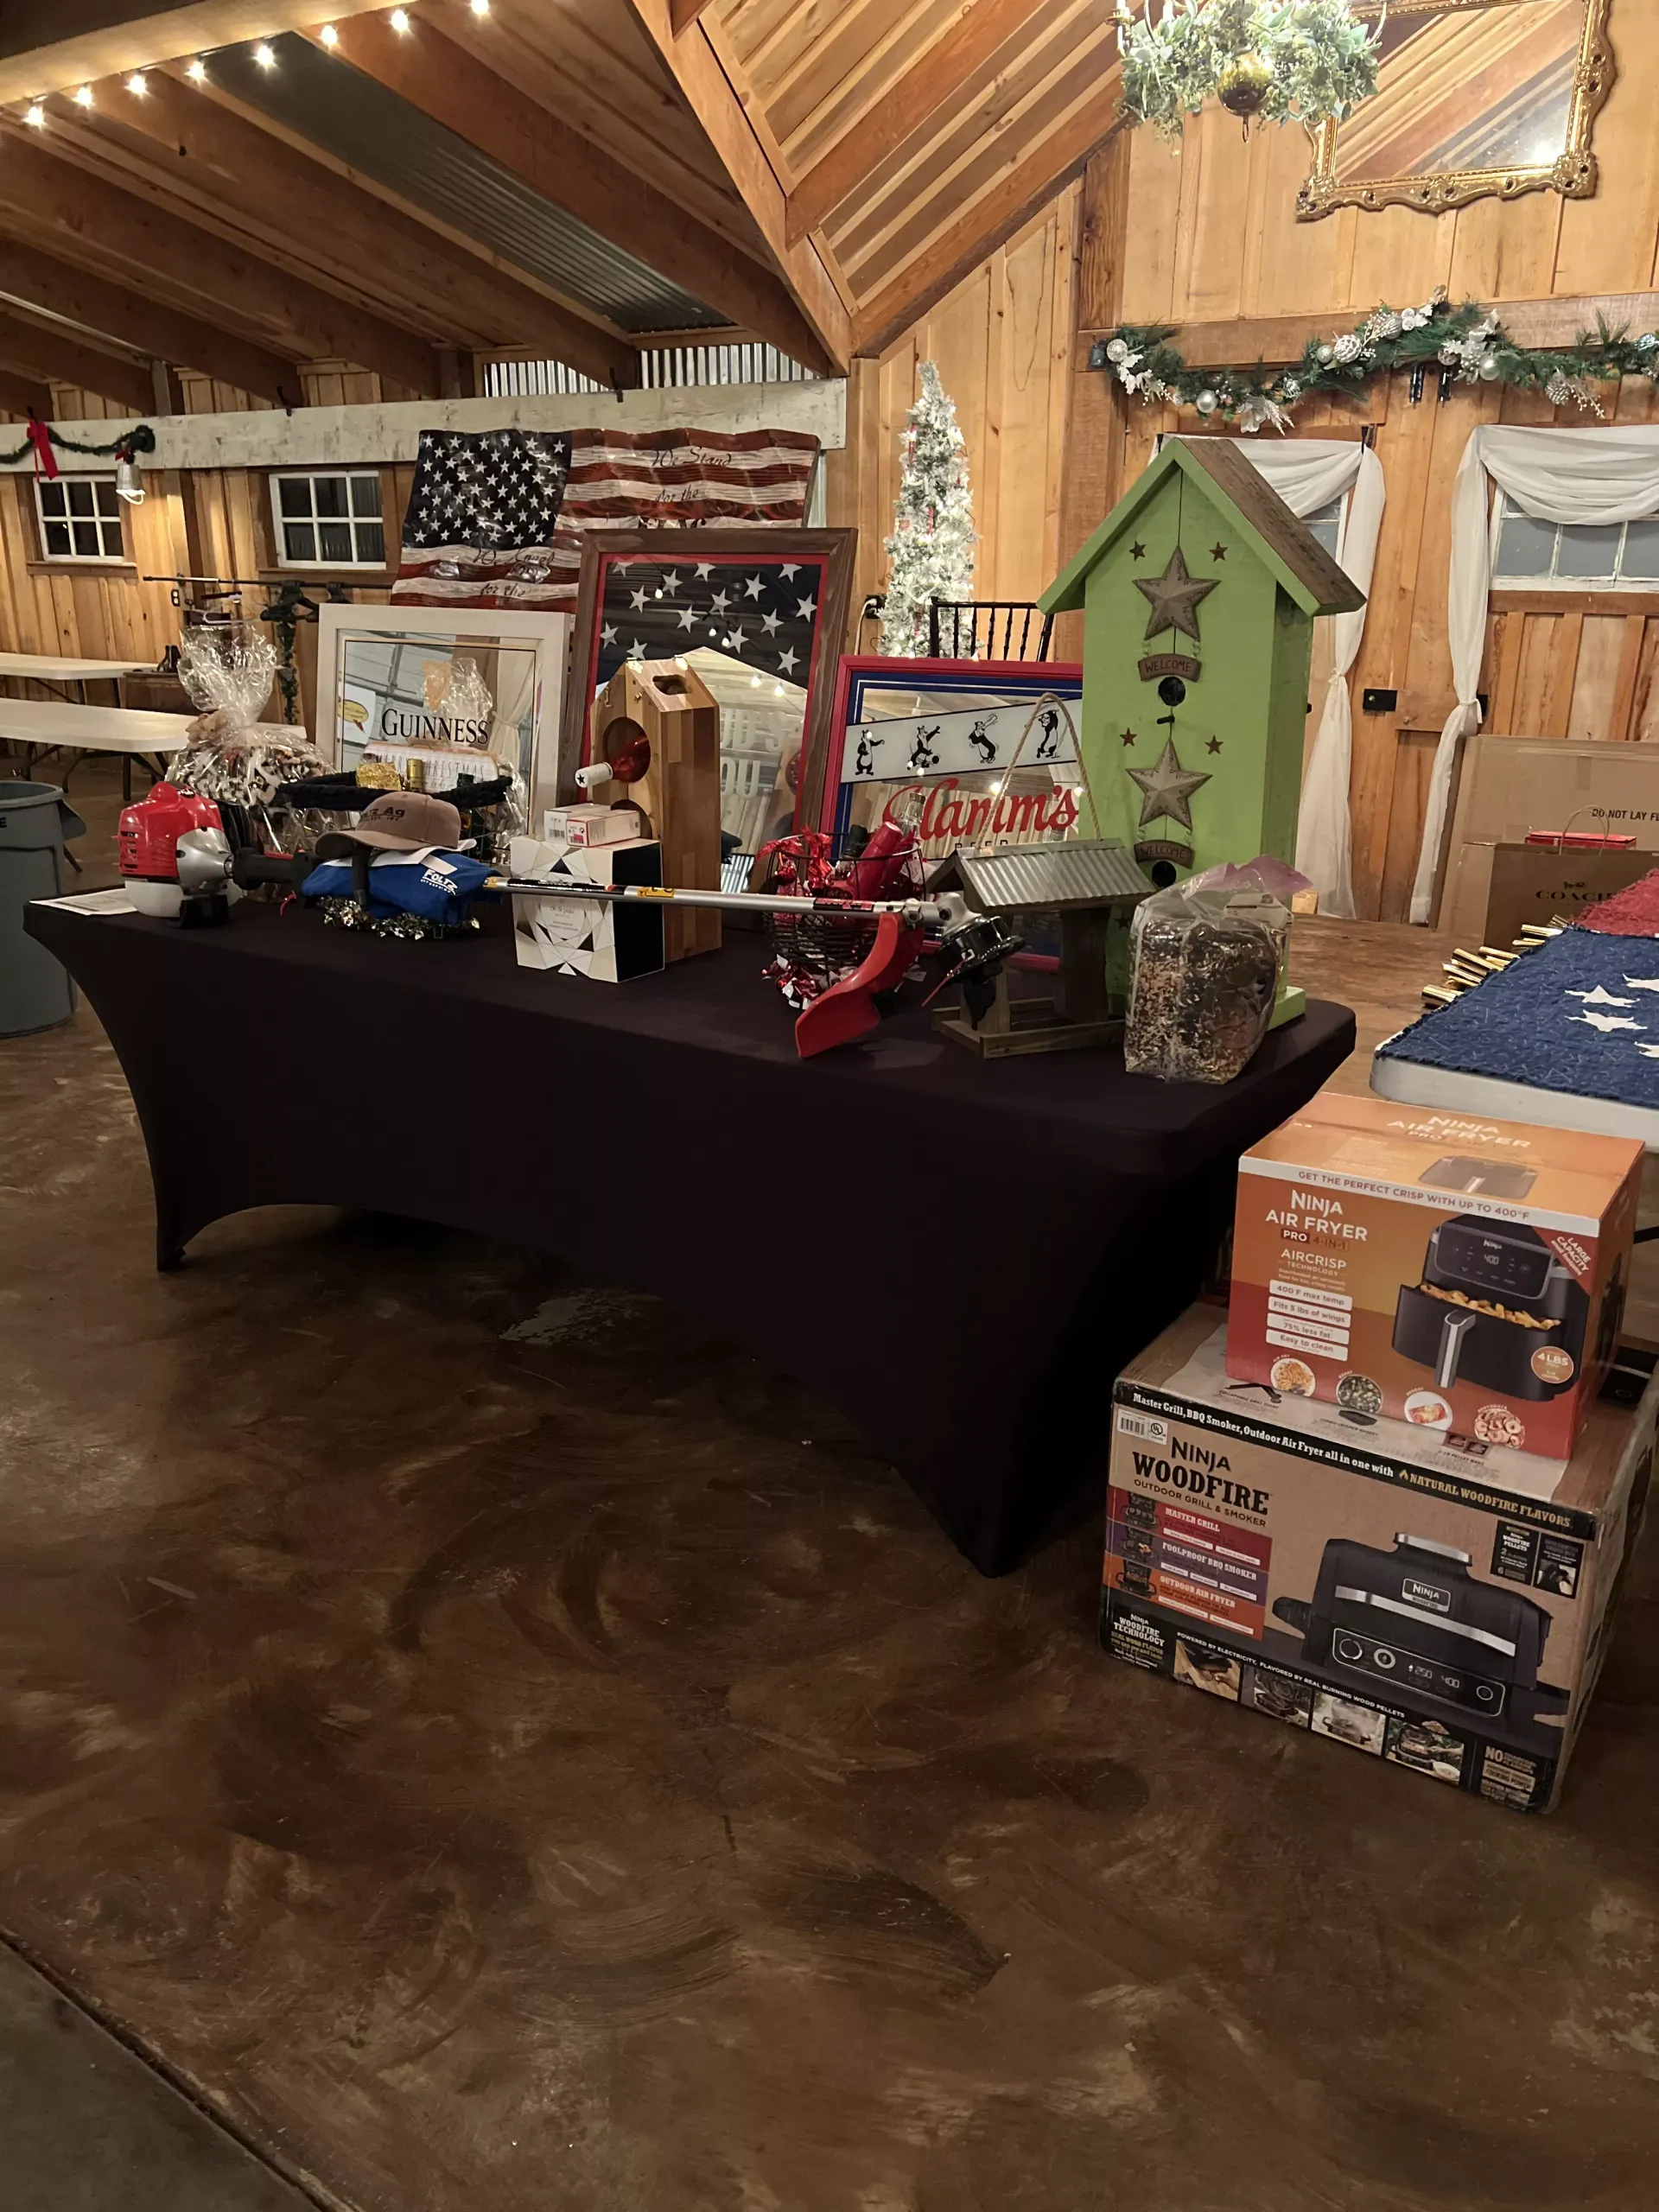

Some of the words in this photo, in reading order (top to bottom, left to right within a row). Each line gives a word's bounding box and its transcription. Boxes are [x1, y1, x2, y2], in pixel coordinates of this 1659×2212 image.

[651, 448, 678, 467] We
[684, 445, 732, 467] Stand
[655, 488, 676, 503] for
[681, 485, 699, 501] the
[480, 583, 497, 596] for
[1143, 659, 1192, 673] WELCOME
[381, 708, 490, 745] GUINNESS
[383, 806, 404, 818] Ag
[1592, 808, 1605, 818] DO
[1608, 810, 1626, 819] NOT
[1630, 810, 1648, 821] LAY
[1140, 844, 1185, 860] WELCOME
[423, 868, 459, 892] FOLTZ
[1387, 1120, 1434, 1133] AIR
[1441, 1128, 1532, 1148] FRYER
[1427, 1116, 1499, 1135] NINJA
[1291, 1189, 1344, 1217] NINJA
[1299, 1171, 1319, 1181] GET
[1321, 1174, 1342, 1186] THE
[1344, 1179, 1391, 1195] PERFECT
[1392, 1188, 1424, 1200] CRISP
[1427, 1194, 1457, 1208] WITH
[1459, 1201, 1474, 1211] UP
[1476, 1203, 1492, 1214] TO
[1265, 1209, 1300, 1229] AIR
[1303, 1217, 1369, 1242] FRYER
[1282, 1229, 1308, 1243] PRO
[1313, 1236, 1348, 1251] 4-IN-1
[1483, 1238, 1503, 1250] NINJA
[1567, 1236, 1592, 1263] LARGE
[1280, 1248, 1348, 1271] AIRCRISP
[1484, 1254, 1500, 1266] 400
[1556, 1236, 1589, 1272] CAPACITY
[1287, 1260, 1339, 1277] TECHNOLOGY
[1276, 1285, 1294, 1294] 400
[1303, 1291, 1321, 1300] max
[1322, 1294, 1345, 1306] temp
[1273, 1300, 1289, 1310] Fits
[1297, 1305, 1310, 1315] lbs
[1321, 1312, 1346, 1324] wings
[1283, 1321, 1300, 1332] 75%
[1302, 1325, 1318, 1336] less
[1319, 1331, 1331, 1339] fat
[1280, 1333, 1300, 1344] Easy
[1311, 1341, 1334, 1353] clean
[1537, 1352, 1546, 1362] 4
[1547, 1354, 1569, 1366] LBS
[1133, 1392, 1163, 1411] Master
[1163, 1401, 1186, 1419] Grill,
[1186, 1408, 1205, 1424] BBQ
[1206, 1414, 1244, 1436] Smoker,
[1243, 1425, 1281, 1446] Outdoor
[1281, 1437, 1297, 1450] Air
[1298, 1440, 1325, 1457] Fryer
[1325, 1449, 1338, 1463] all
[1339, 1453, 1351, 1465] in
[1351, 1458, 1370, 1471] one
[1371, 1464, 1395, 1478] with
[1171, 1436, 1232, 1473] NINJA
[1132, 1451, 1270, 1516] WOODFIRE
[1134, 1478, 1182, 1500] OUTDOOR
[1185, 1495, 1212, 1512] GRILL
[1224, 1508, 1267, 1528] SMOKER
[1408, 1472, 1459, 1497] NATURAL
[1461, 1487, 1519, 1514] WOODFIRE
[1519, 1505, 1572, 1529] FLAVORS
[1165, 1507, 1197, 1525] MASTER
[1197, 1517, 1221, 1533] GRILL
[1162, 1541, 1208, 1564] FOOLPROOF
[1208, 1558, 1224, 1571] BBQ
[1224, 1563, 1258, 1581] SMOKER
[1160, 1575, 1196, 1594] OUTDOOR
[1196, 1588, 1210, 1599] AIR
[1210, 1592, 1236, 1608] FRYER
[1412, 1583, 1440, 1599] NINJA
[1119, 1617, 1160, 1638] WOODFIRE
[1130, 1613, 1149, 1625] NINJA
[1114, 1622, 1166, 1647] TECHNOLOGY
[1177, 1631, 1208, 1647] POWERED
[1259, 1662, 1294, 1678] FLAVORED
[1304, 1677, 1321, 1688] REAL
[1322, 1684, 1353, 1700] BURNING
[1353, 1695, 1376, 1708] WOOD
[1376, 1704, 1406, 1719] PELLETS
[1414, 1665, 1433, 1680] 250
[1440, 1675, 1461, 1689] 400
[1484, 1745, 1504, 1764] NO
